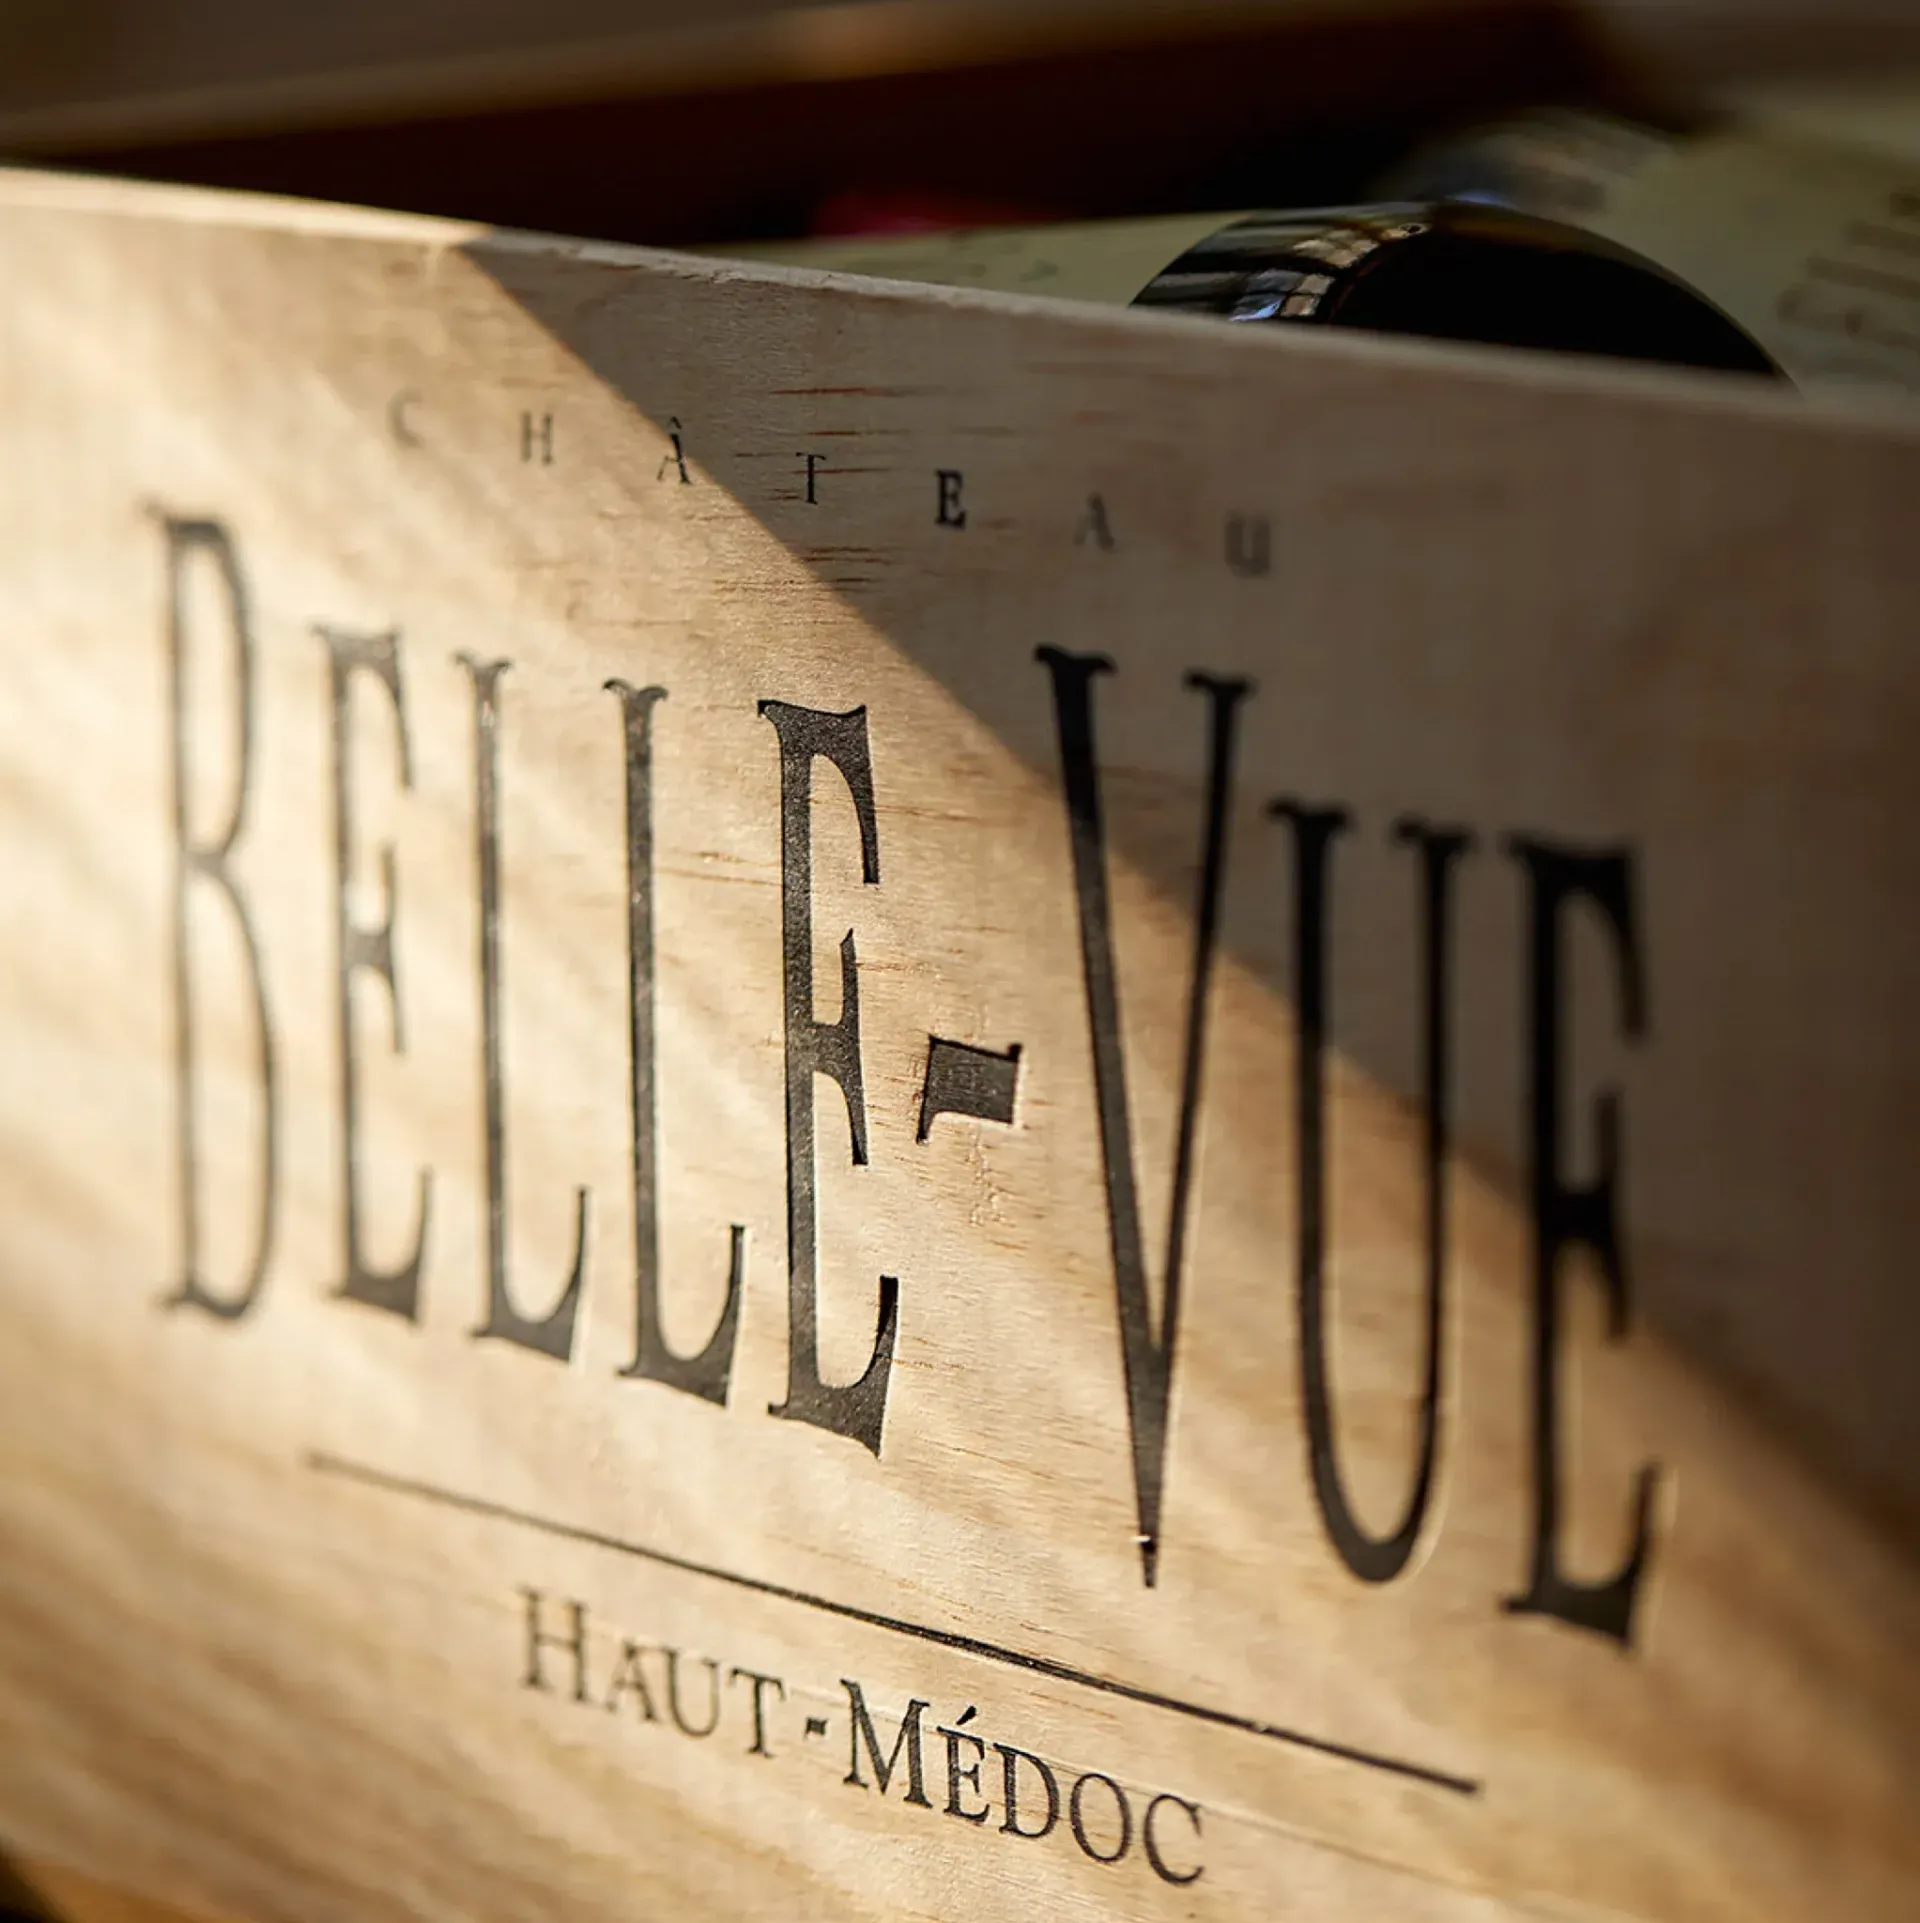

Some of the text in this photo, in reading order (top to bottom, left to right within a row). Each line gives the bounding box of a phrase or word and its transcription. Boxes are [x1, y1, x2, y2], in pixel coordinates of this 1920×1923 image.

[388, 391, 1274, 577] CHÂTEAU
[146, 499, 1662, 1652] BELLE-VUE
[517, 1588, 1206, 1886] HAUT-MÉDOC
